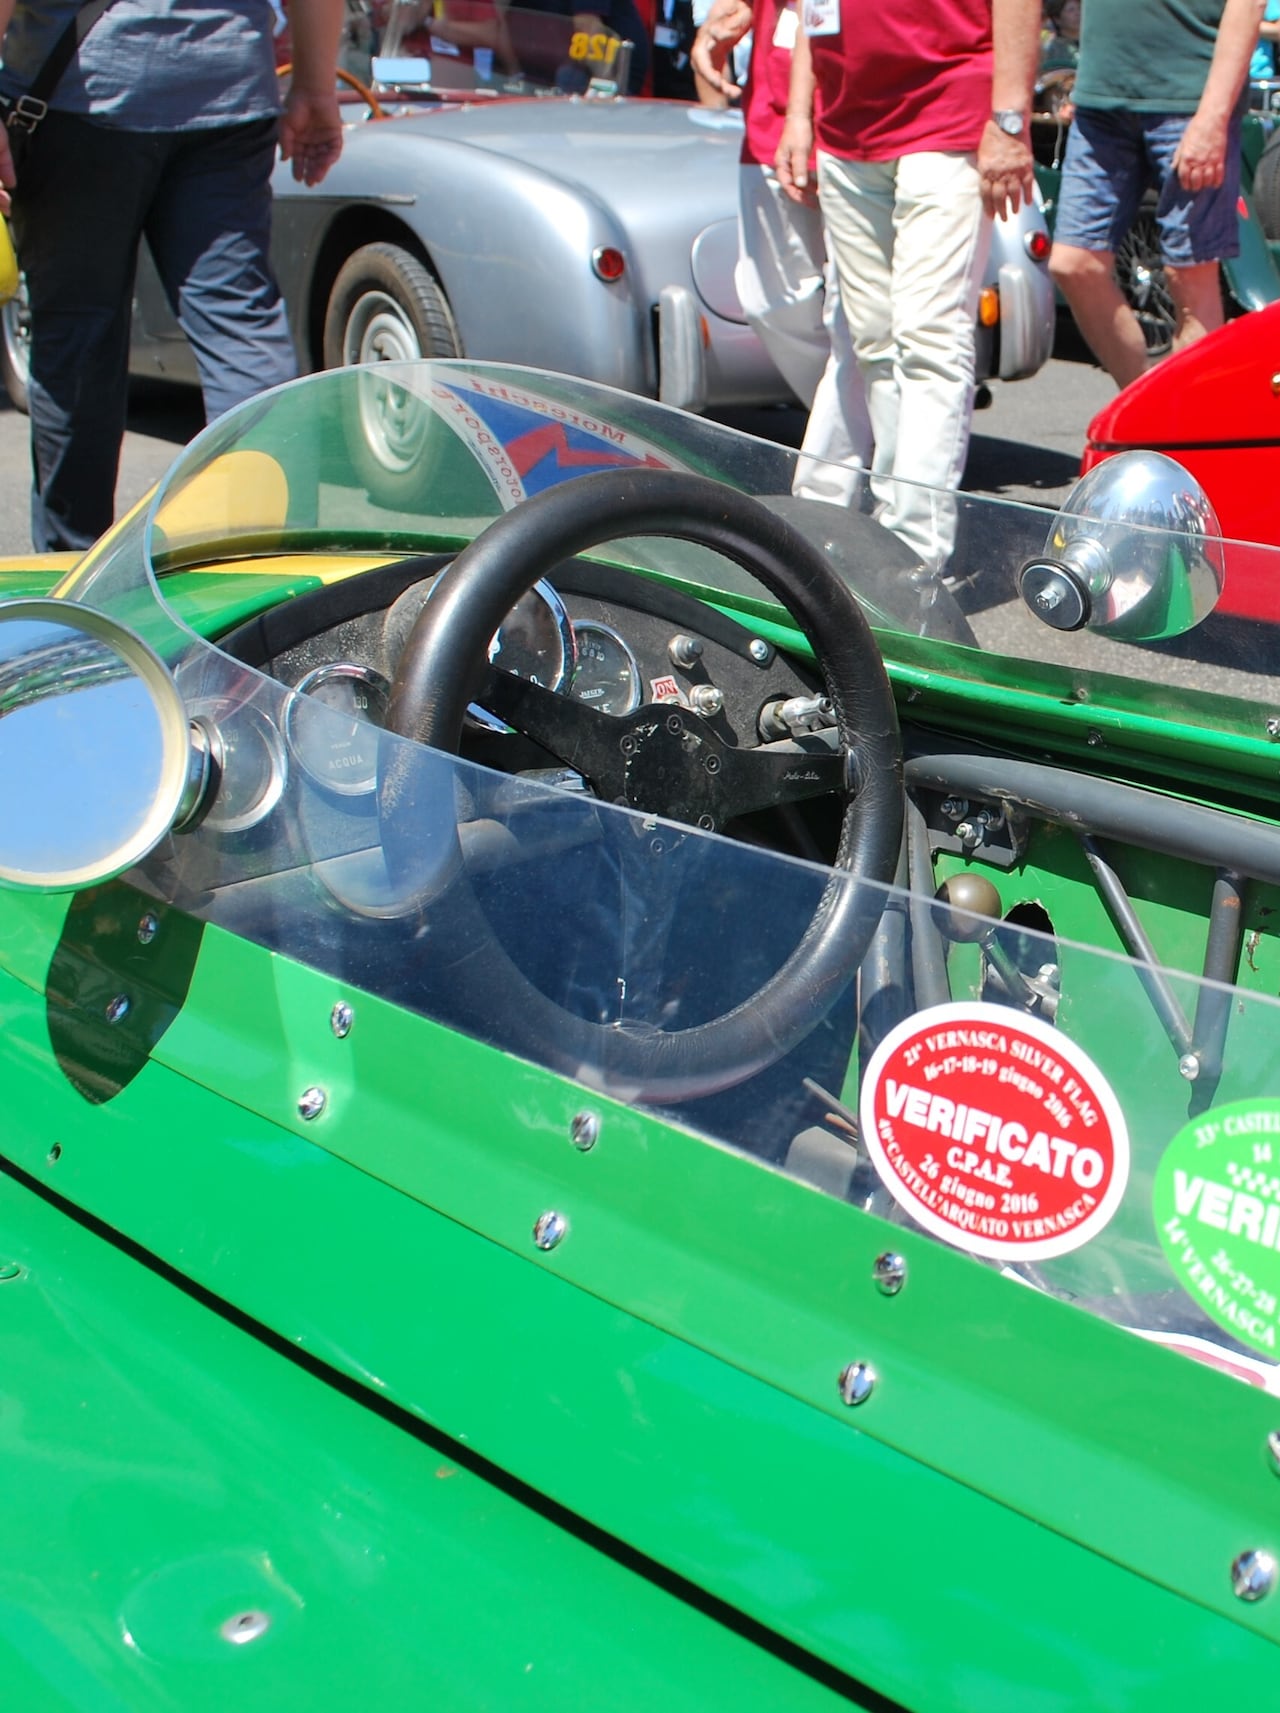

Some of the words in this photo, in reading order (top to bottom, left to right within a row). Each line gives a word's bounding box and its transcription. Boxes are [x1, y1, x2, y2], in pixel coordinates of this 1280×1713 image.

[656, 681, 675, 697] ON
[327, 754, 364, 770] ACQUA
[923, 1054, 998, 1081] 16-17-18-19
[997, 1065, 1044, 1100] giugno
[1043, 1092, 1074, 1129] 2016
[924, 1029, 1007, 1054] VERNASCA
[1009, 1039, 1065, 1084] SILVER
[1062, 1077, 1099, 1127] FLAG
[885, 1077, 1105, 1189] VERIFICATO
[1252, 1141, 1272, 1164] 14
[919, 1153, 942, 1179] 26
[939, 1174, 996, 1210] giugno
[1000, 1191, 1040, 1214] 2016
[946, 1145, 1014, 1189] C.P.A.E.
[1011, 1192, 1097, 1239] VERNASCA
[1180, 1244, 1276, 1349] VERNASCA
